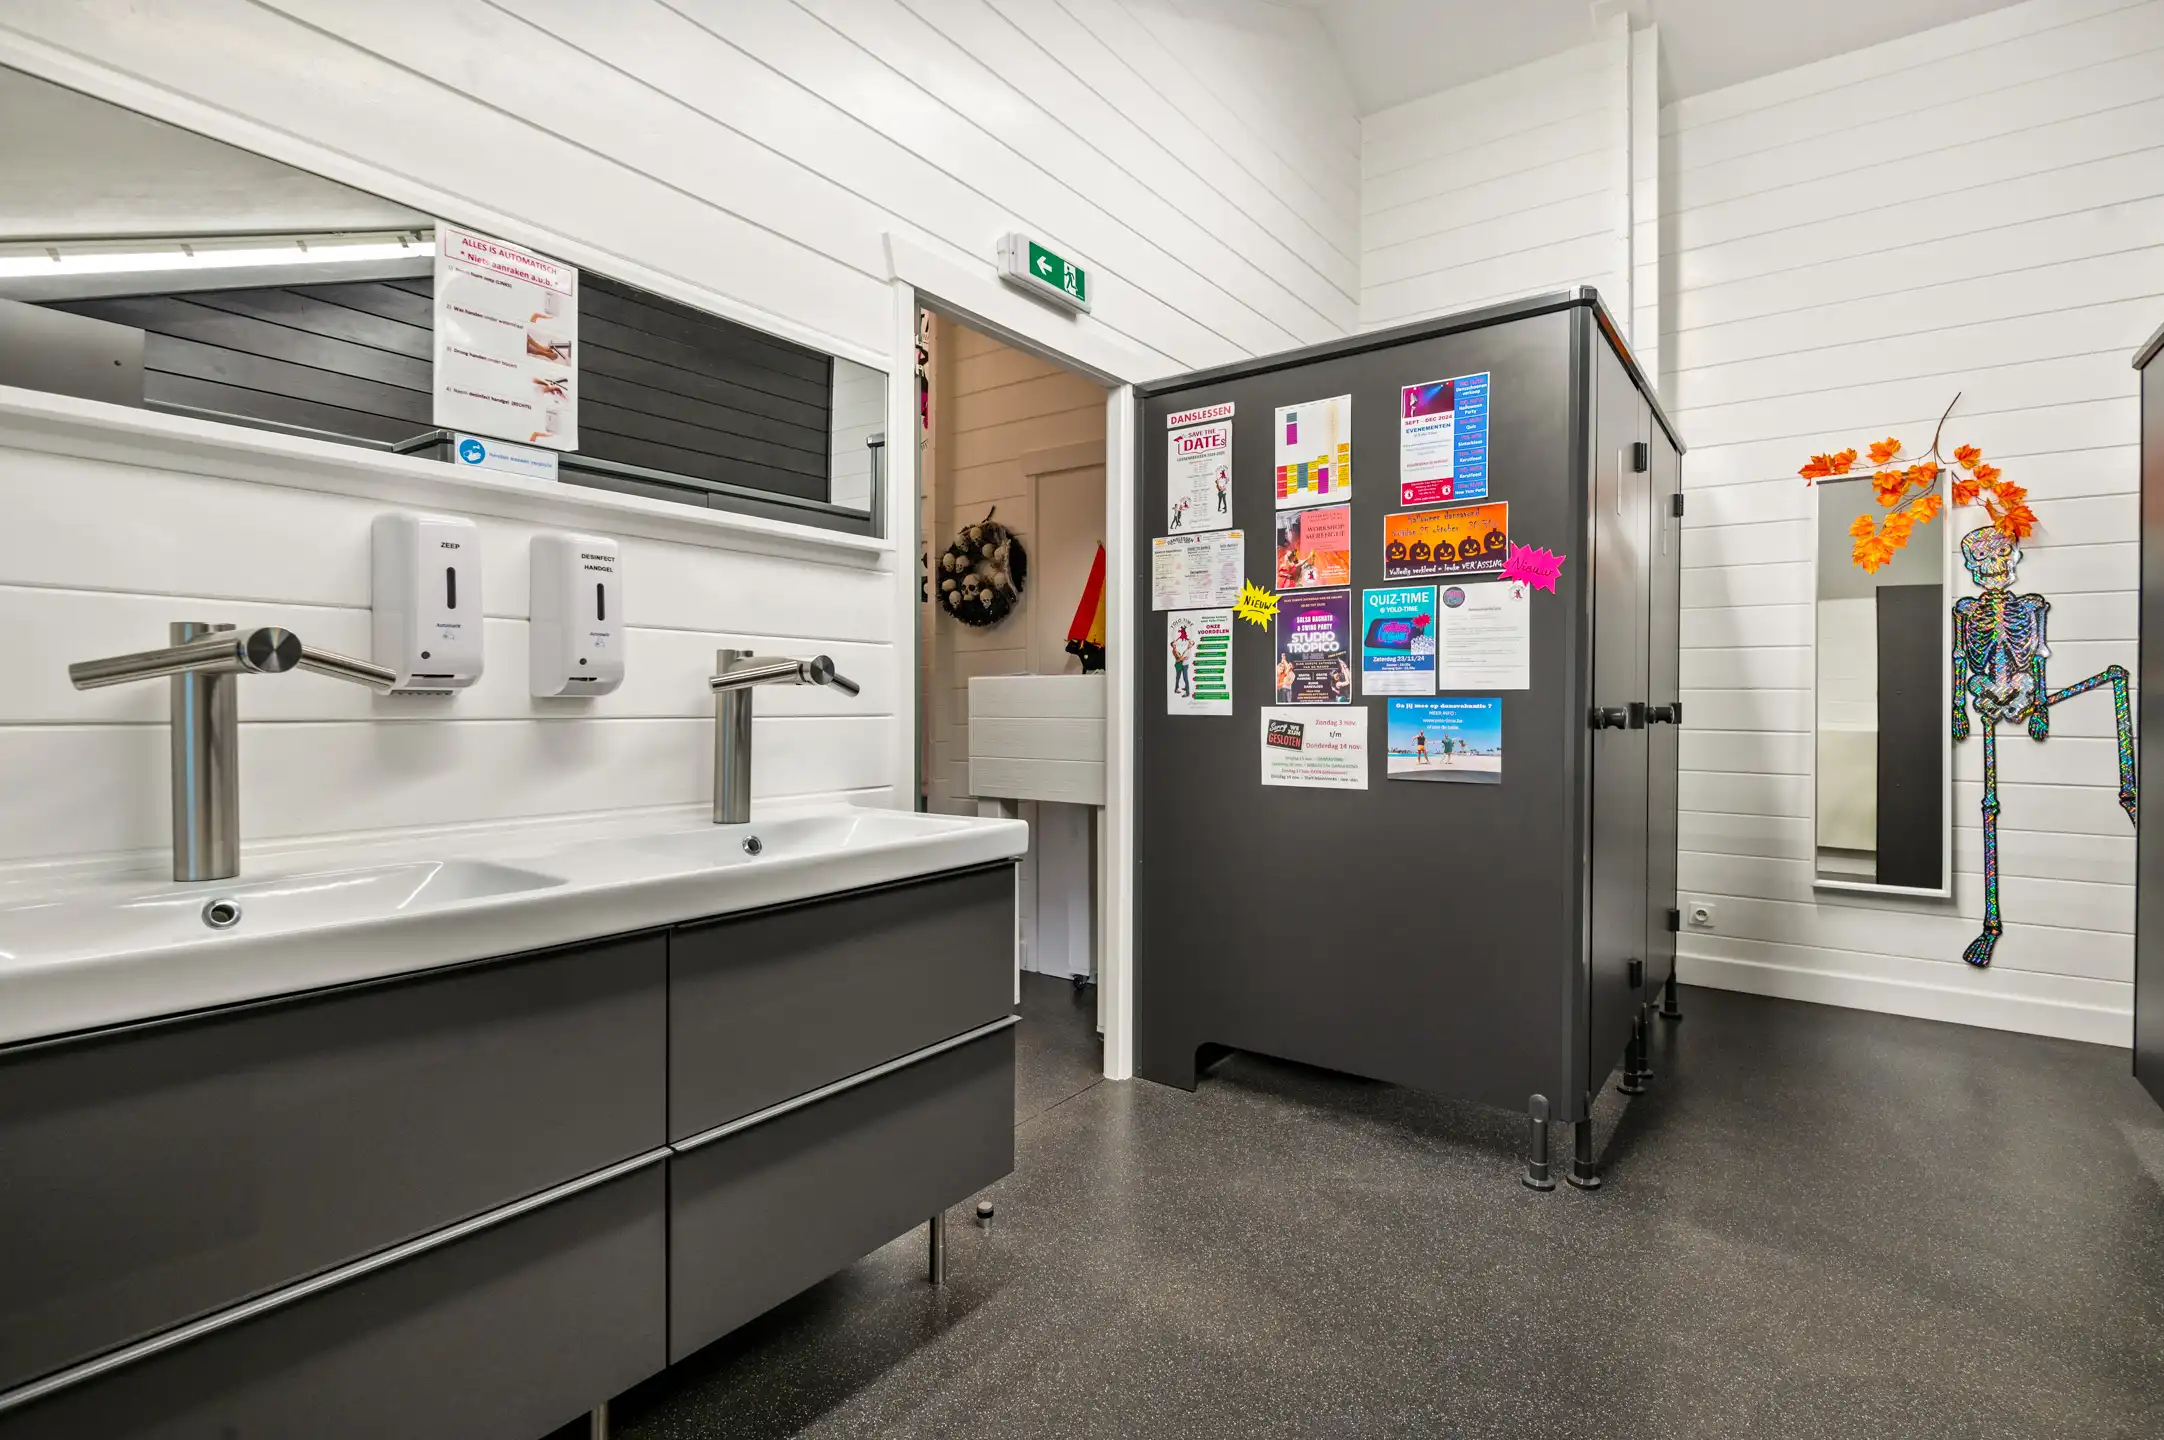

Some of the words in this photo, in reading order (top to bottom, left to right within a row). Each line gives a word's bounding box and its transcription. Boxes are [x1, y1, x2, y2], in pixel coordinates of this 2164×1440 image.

[462, 238, 487, 251] ALLES
[489, 246, 496, 254] IS
[499, 250, 557, 275] AUTOMATISCH
[467, 253, 489, 265] Niets
[492, 262, 529, 277] aanraken
[531, 274, 552, 286] a.u.b.
[1171, 405, 1231, 425] DANSLESSEN
[1188, 430, 1203, 438] SAVE
[1406, 423, 1451, 434] EVENEMENTEN
[441, 542, 460, 550] ZEEP
[581, 553, 616, 563] DESINFECT
[584, 564, 614, 573] HANDGEL
[1389, 566, 1411, 576] Volledig
[1412, 564, 1436, 574] verkleed
[1511, 557, 1553, 576] Nieuw
[1369, 591, 1430, 607] QUIZ-TIME
[1291, 631, 1335, 644] STUDIO
[1287, 641, 1340, 653] TROPICO
[1270, 722, 1287, 732] Sorry
[1268, 733, 1301, 747] GESLOTEN
